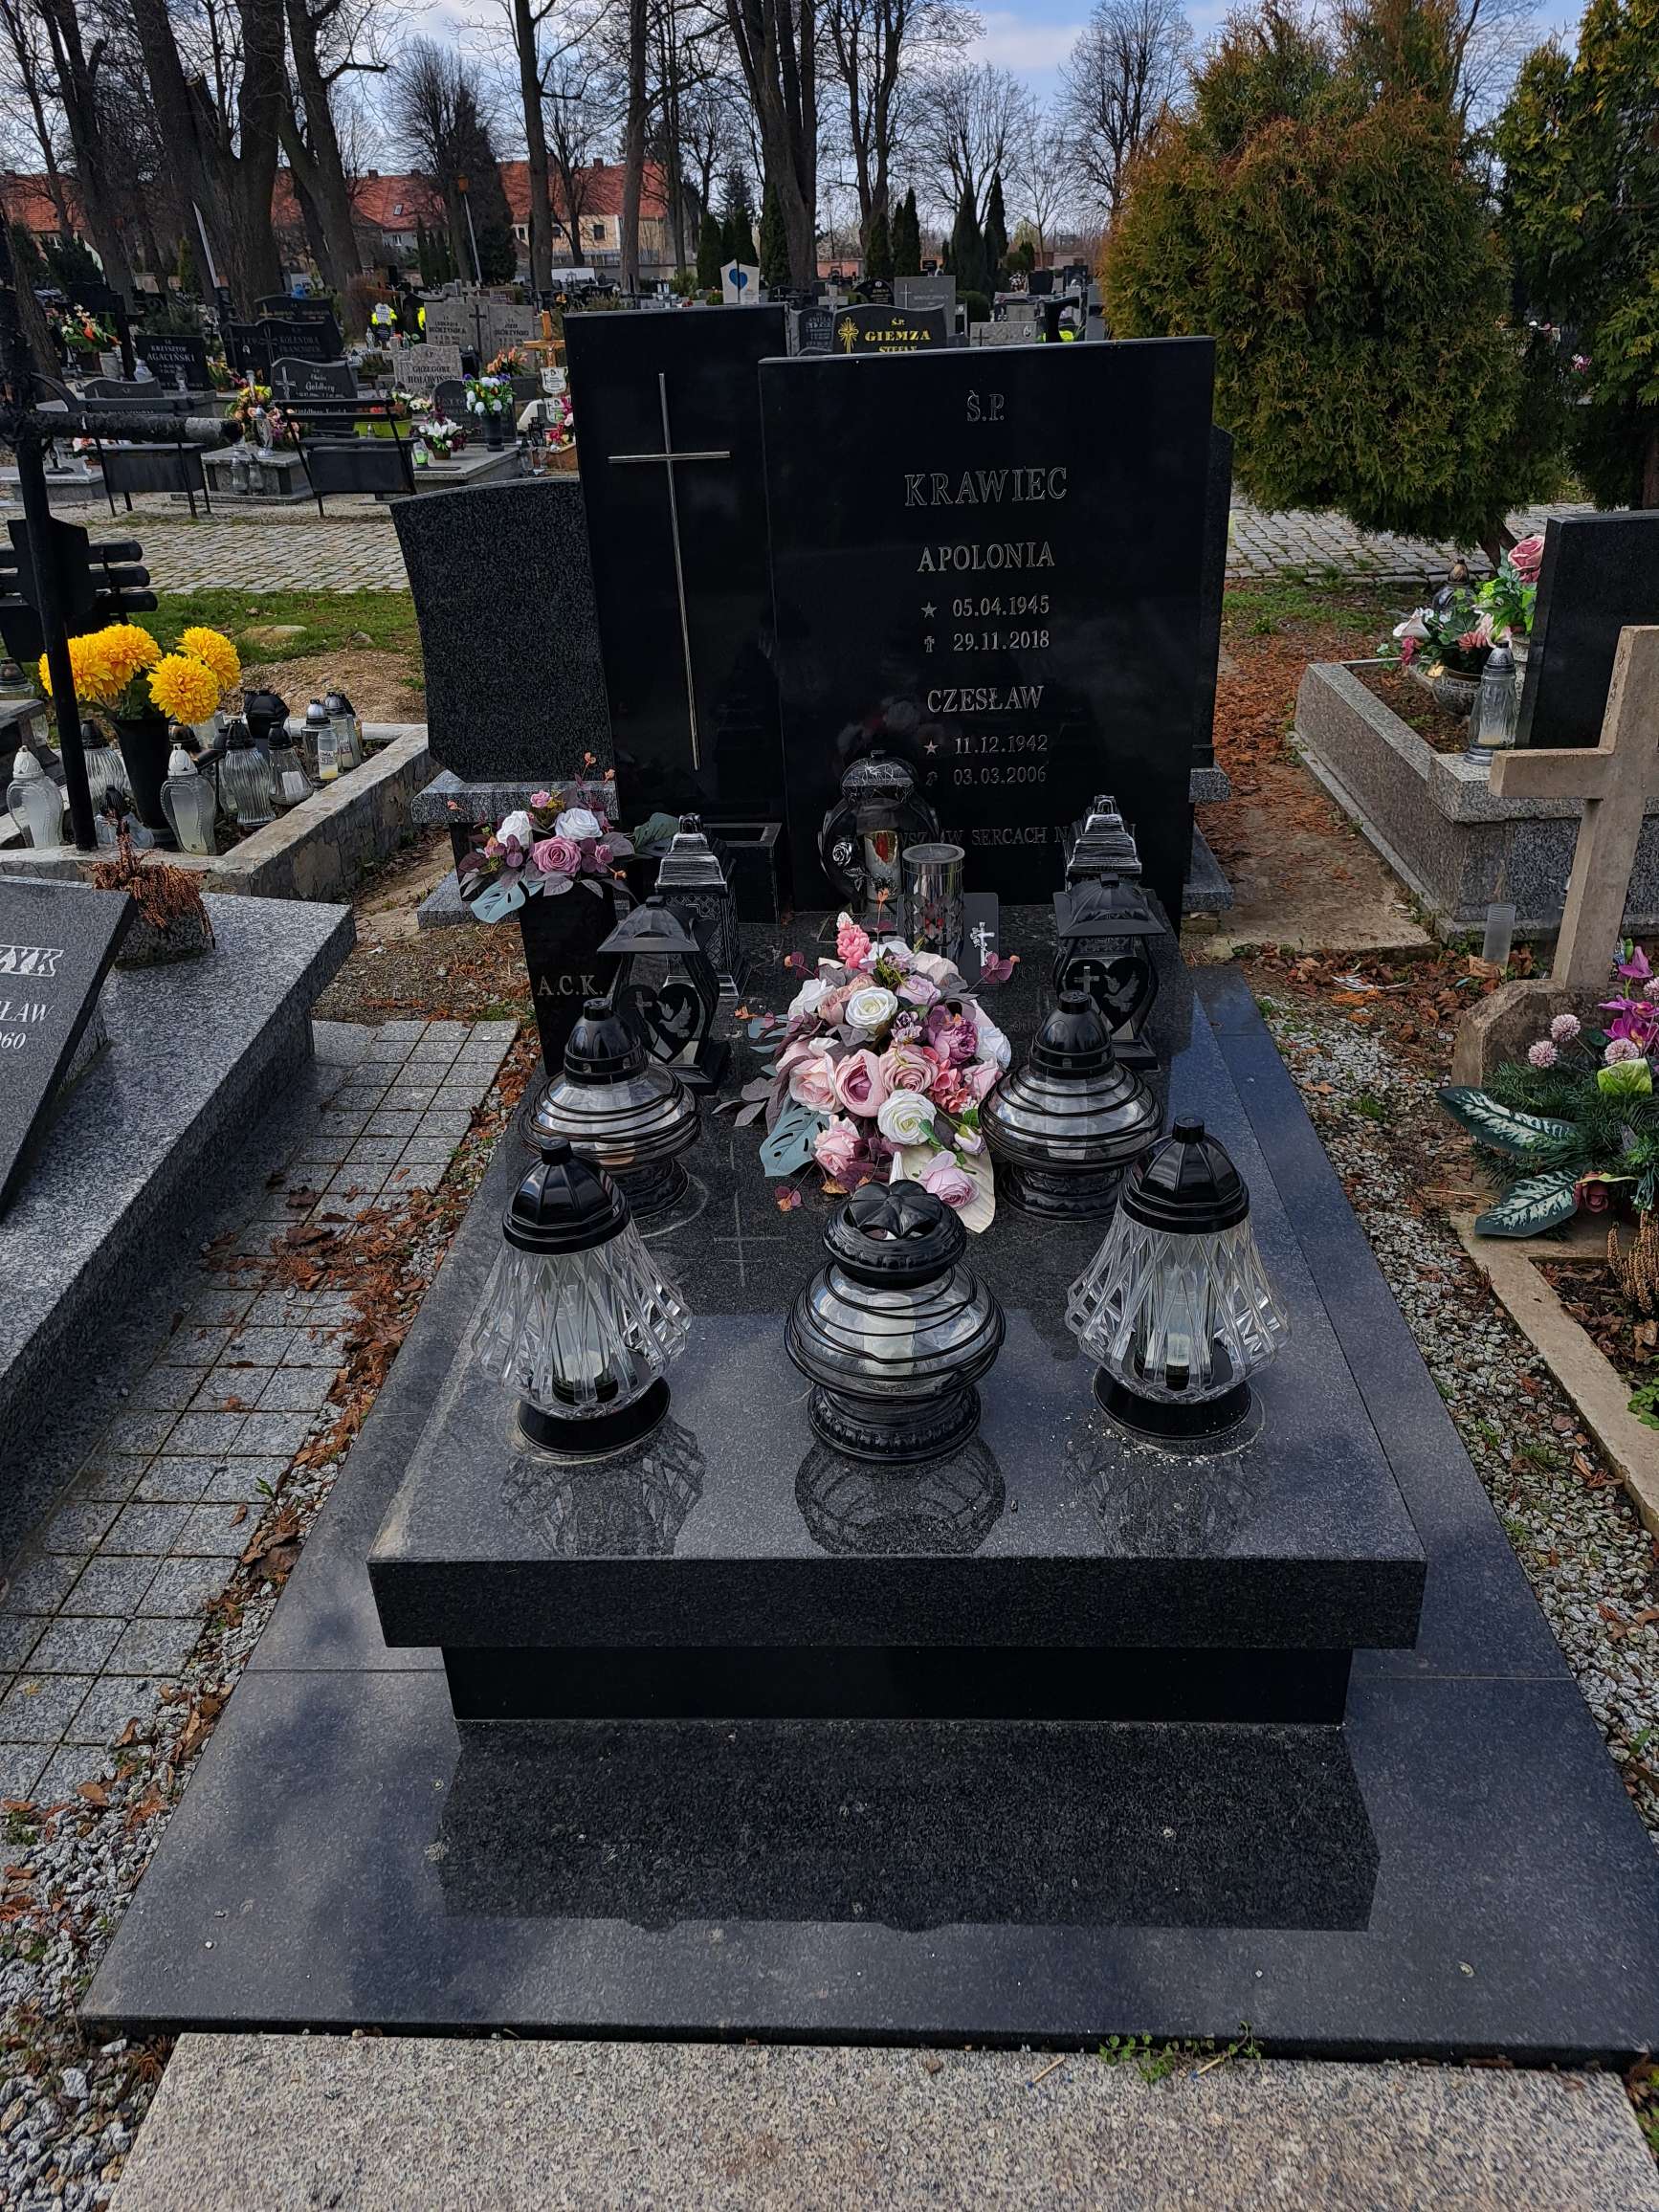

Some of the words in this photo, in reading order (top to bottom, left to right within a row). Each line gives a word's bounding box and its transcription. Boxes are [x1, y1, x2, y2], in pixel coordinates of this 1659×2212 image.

[864, 328, 932, 342] GIEMZA
[966, 389, 1005, 422] Ś.P.
[904, 466, 1068, 507] KRAWIEC
[917, 541, 1056, 573] APOLONIA
[951, 594, 1051, 618] 05.04.1945
[952, 629, 1051, 652] 29.11.2018
[926, 685, 1045, 714] CZESŁAW
[954, 734, 1049, 756] 11.12.1942
[952, 765, 1047, 786] 03.03.2006
[971, 827, 1049, 846] SERCACH
[537, 974, 604, 996] A.C.K.
[0, 1001, 55, 1024] ŁAW
[0, 1031, 27, 1051] 60
